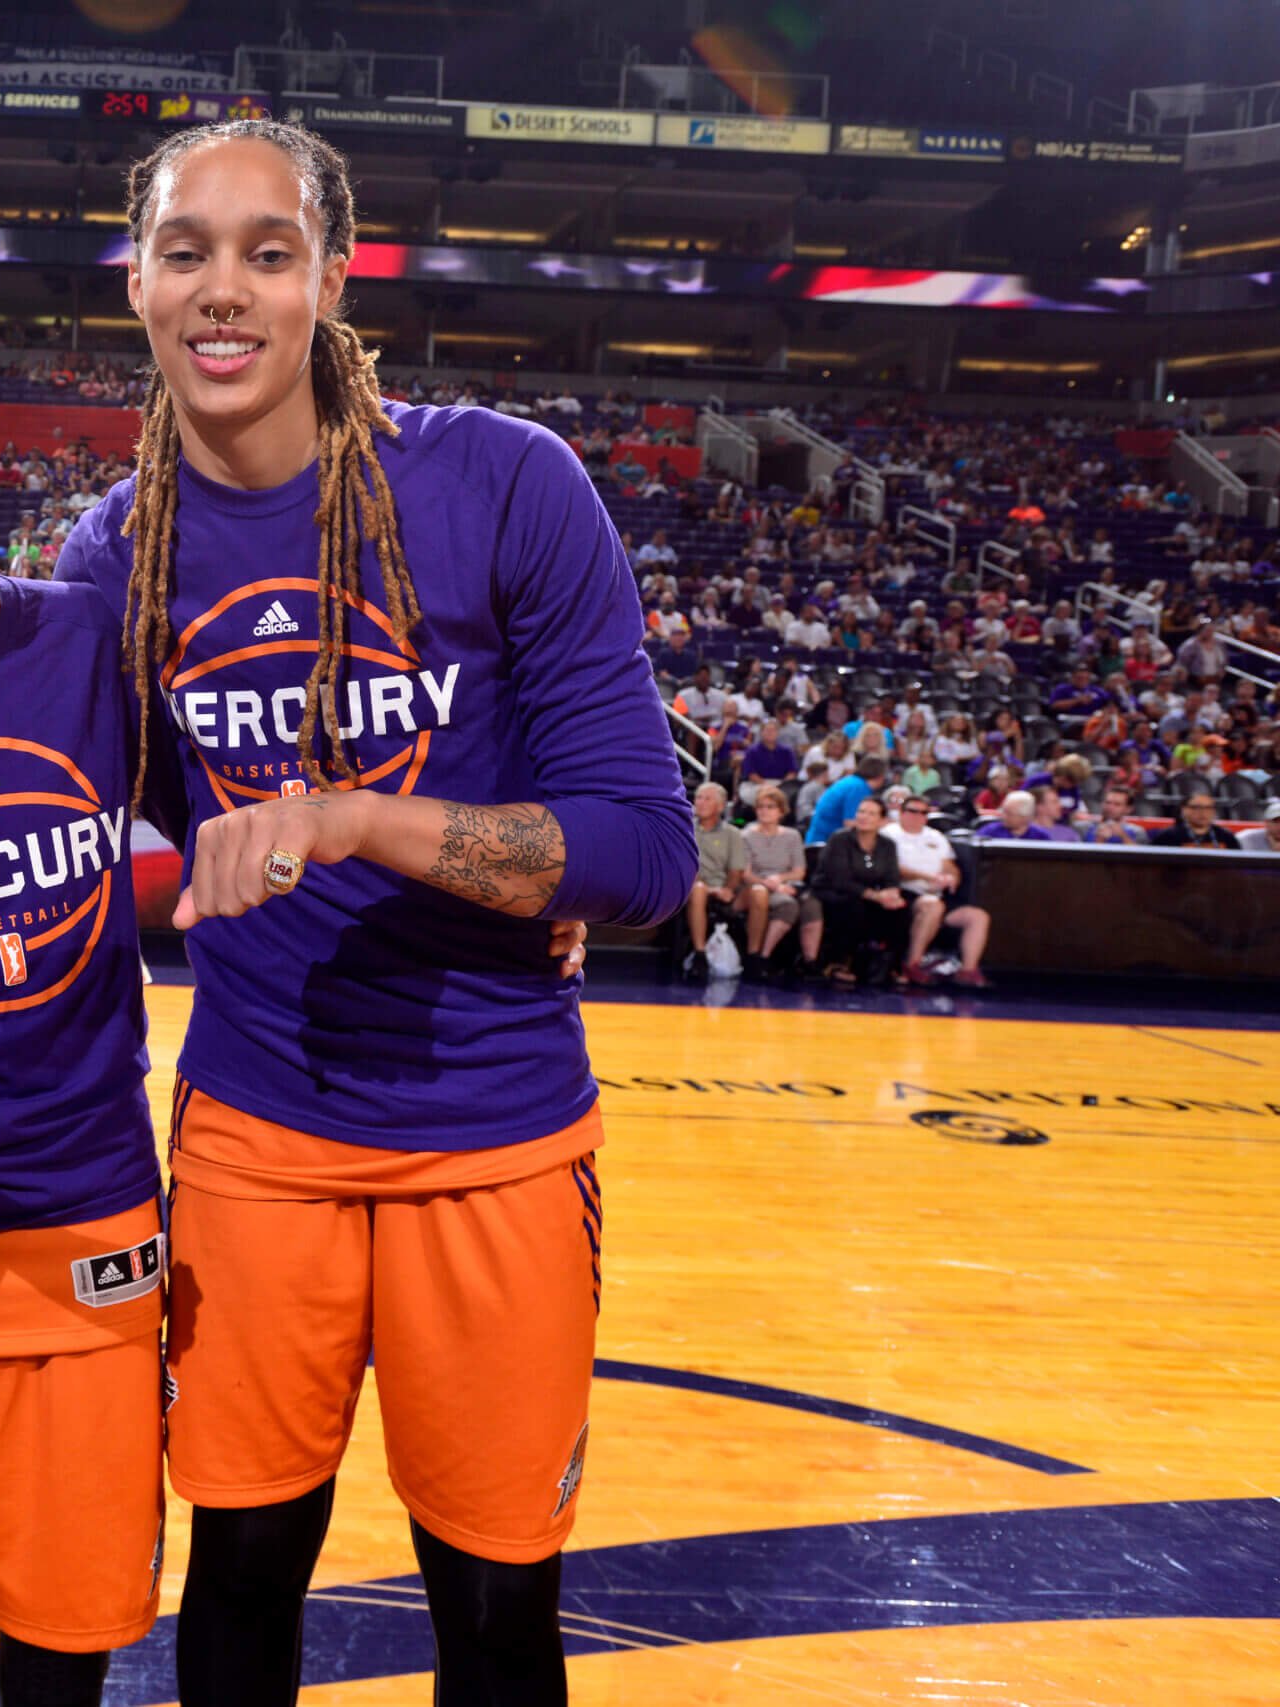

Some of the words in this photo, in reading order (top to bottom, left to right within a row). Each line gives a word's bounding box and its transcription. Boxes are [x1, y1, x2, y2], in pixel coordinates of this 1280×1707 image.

[5, 94, 80, 109] SERVICES
[515, 112, 565, 132] DESERT
[571, 115, 632, 135] SCHOOLS
[253, 619, 299, 637] adidas
[269, 862, 293, 879] USA
[97, 1272, 125, 1285] adidas
